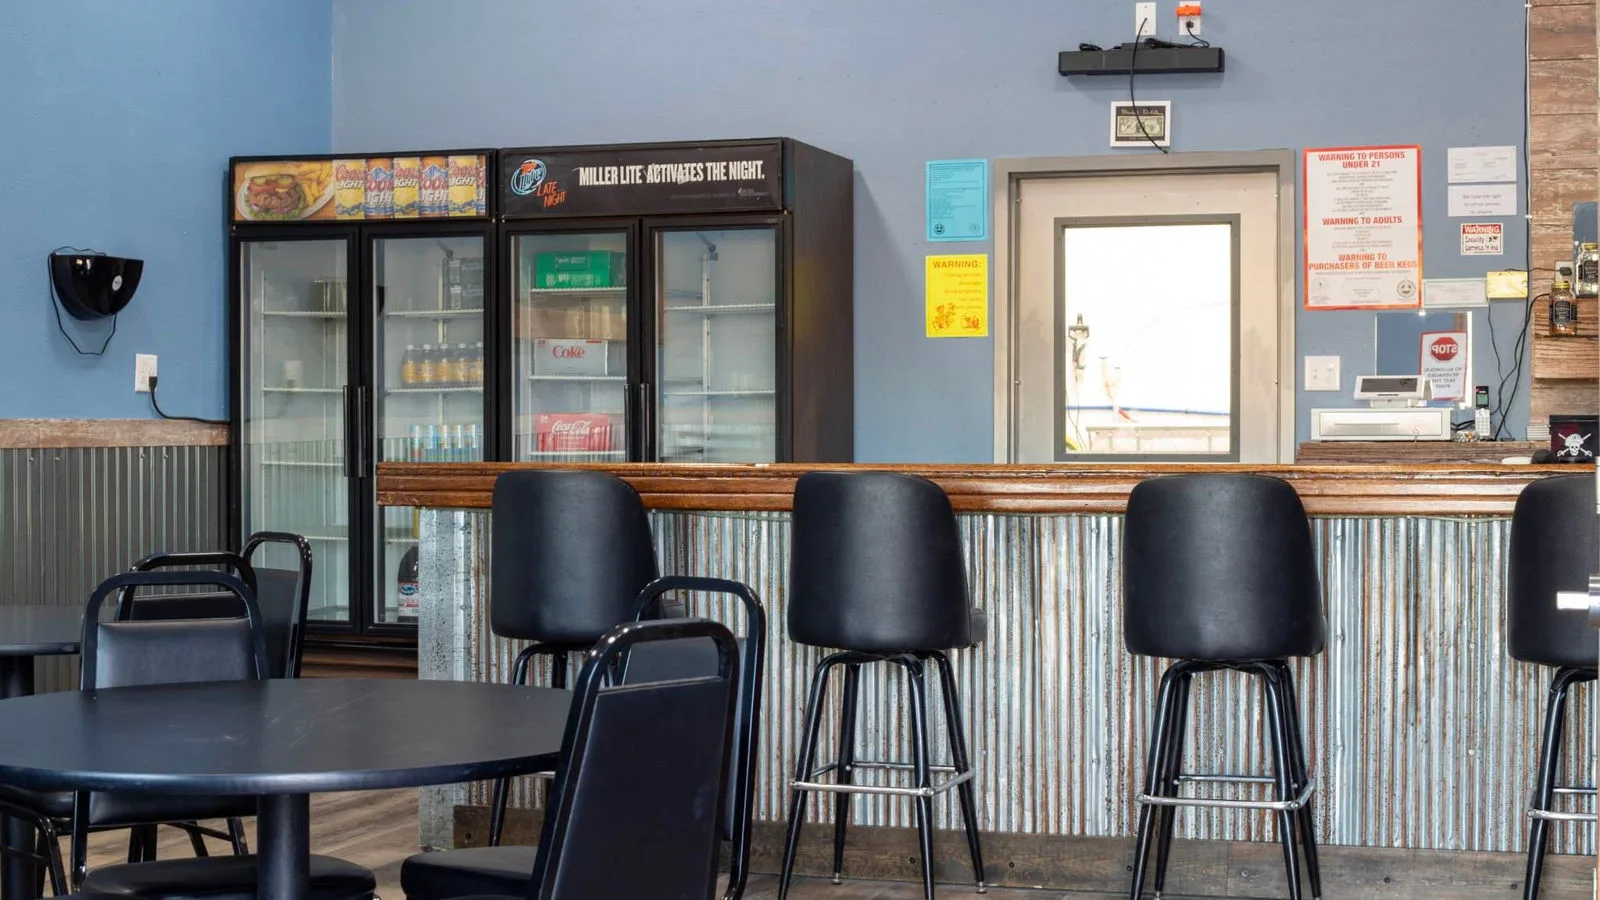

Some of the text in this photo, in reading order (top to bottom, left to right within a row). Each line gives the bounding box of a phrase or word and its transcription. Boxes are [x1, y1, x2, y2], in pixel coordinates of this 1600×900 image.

[1318, 151, 1405, 161] WARNING TO PERSONS
[1343, 160, 1381, 169] UNDER 21
[579, 160, 765, 186] MILLER LITE ACTIVATES THE NIGHT.
[537, 181, 557, 197] LATE
[544, 191, 567, 208] NIGHT
[1322, 215, 1403, 226] WARNING TO ADULTS
[1464, 225, 1501, 234] WARNING
[1338, 253, 1387, 261] WARNING TO
[932, 260, 982, 269] WARNING:
[1309, 260, 1417, 270] PURCHASERS OF BEER KEGS
[552, 345, 585, 359] Coke
